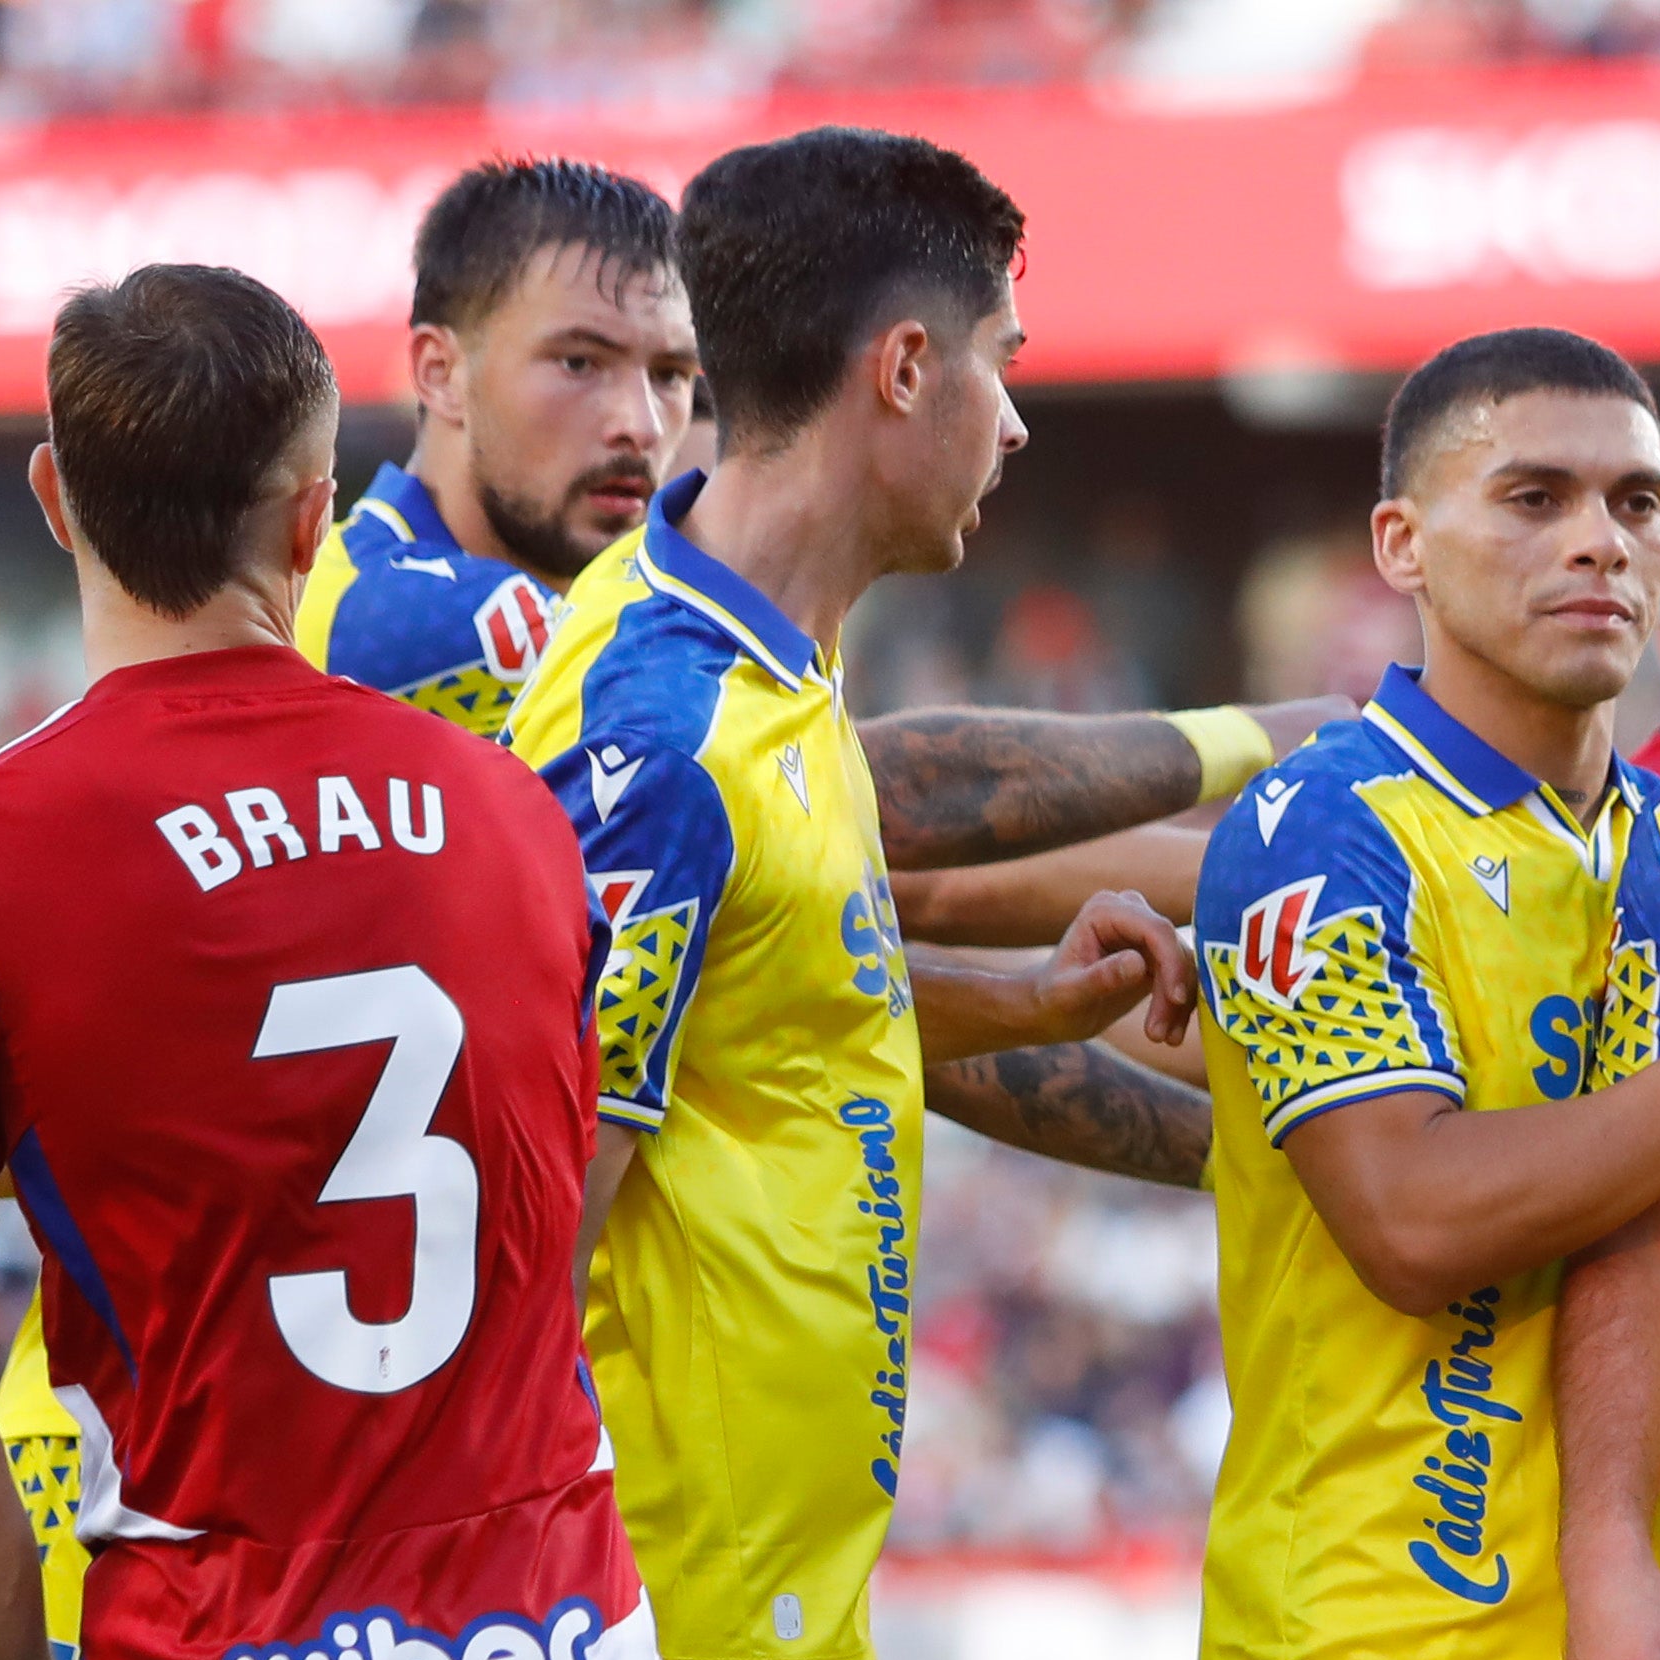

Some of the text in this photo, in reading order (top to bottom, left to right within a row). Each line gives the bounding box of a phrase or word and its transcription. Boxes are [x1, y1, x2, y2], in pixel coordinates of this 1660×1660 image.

[154, 774, 446, 893] BRAU
[251, 963, 480, 1394] 3
[838, 1091, 910, 1336] Turismo
[1407, 1284, 1523, 1605] Cádiz Turis
